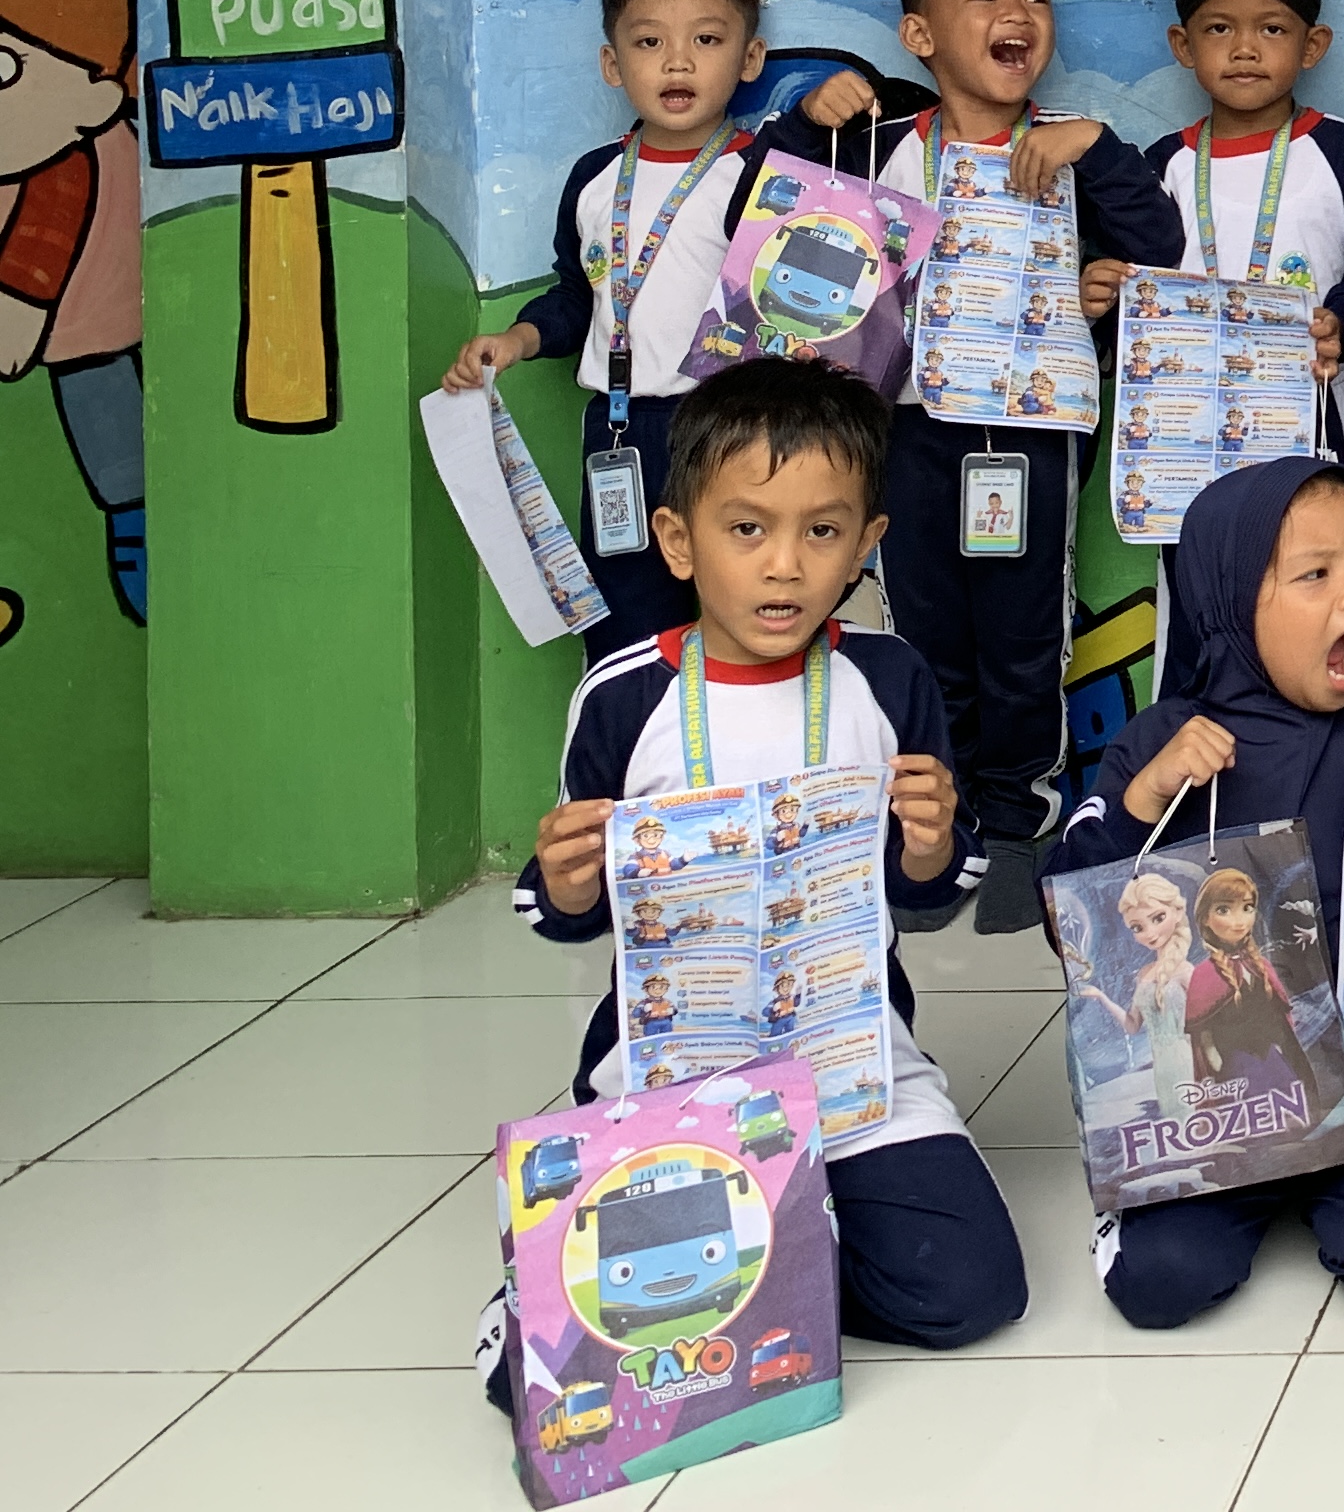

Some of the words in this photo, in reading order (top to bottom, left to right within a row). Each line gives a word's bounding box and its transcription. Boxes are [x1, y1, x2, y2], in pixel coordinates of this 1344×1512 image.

[809, 229, 826, 239] 120
[757, 324, 819, 360] TAYO
[662, 790, 710, 808] PROFESI
[1119, 1083, 1309, 1171] FROZEN
[624, 1183, 651, 1197] 120
[621, 1338, 736, 1389] TAYO
